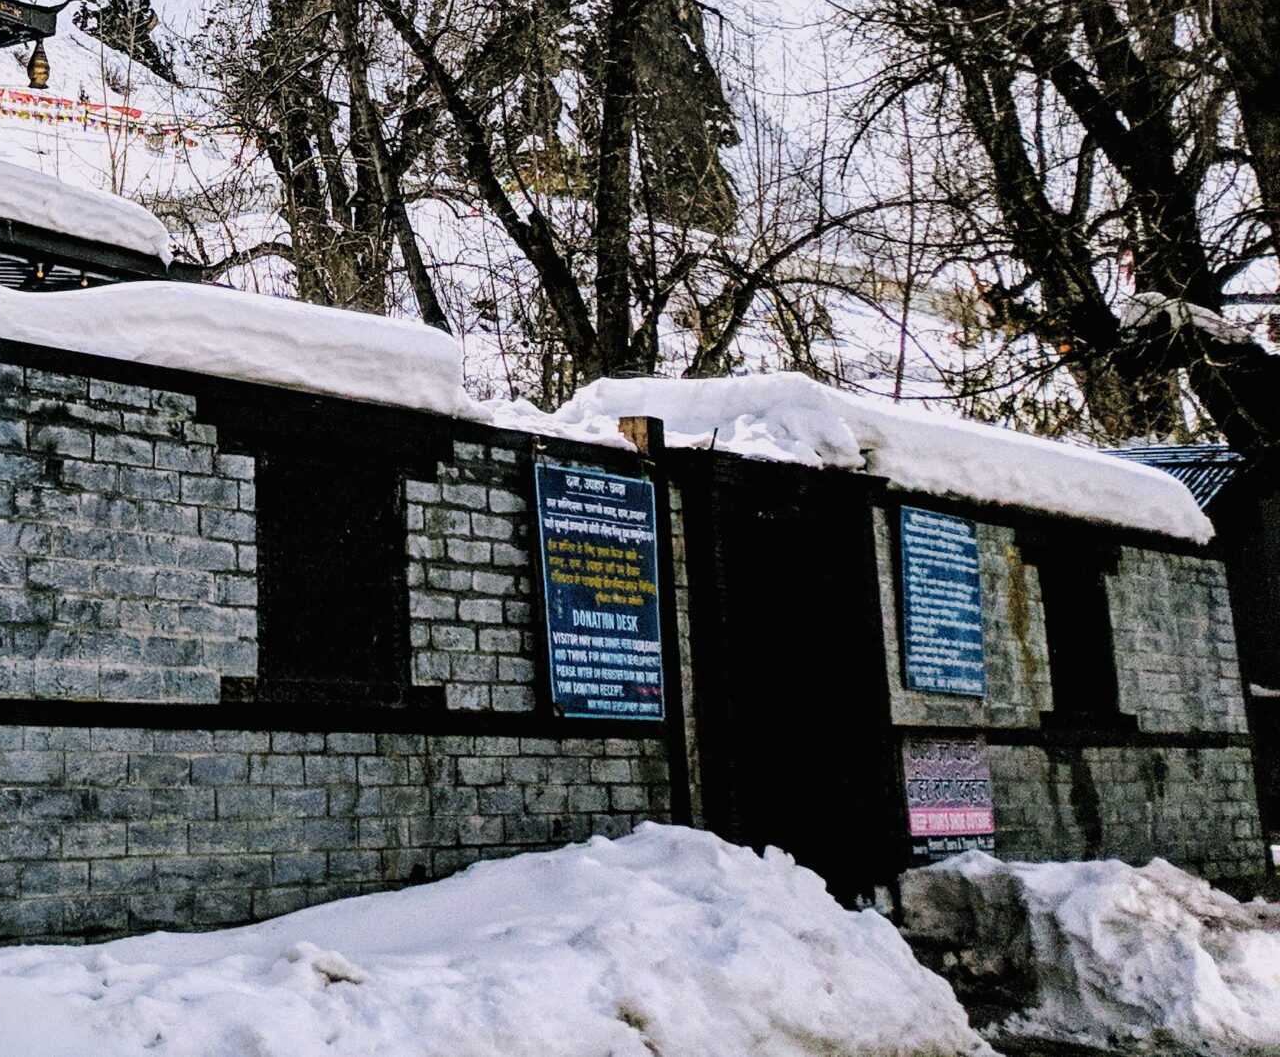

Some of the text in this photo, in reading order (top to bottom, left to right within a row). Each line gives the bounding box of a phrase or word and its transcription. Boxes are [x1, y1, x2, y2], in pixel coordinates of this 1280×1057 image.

[573, 609, 638, 632] DONATION DESK
[552, 631, 579, 645] VISITOR
[556, 665, 577, 677] PLEASE
